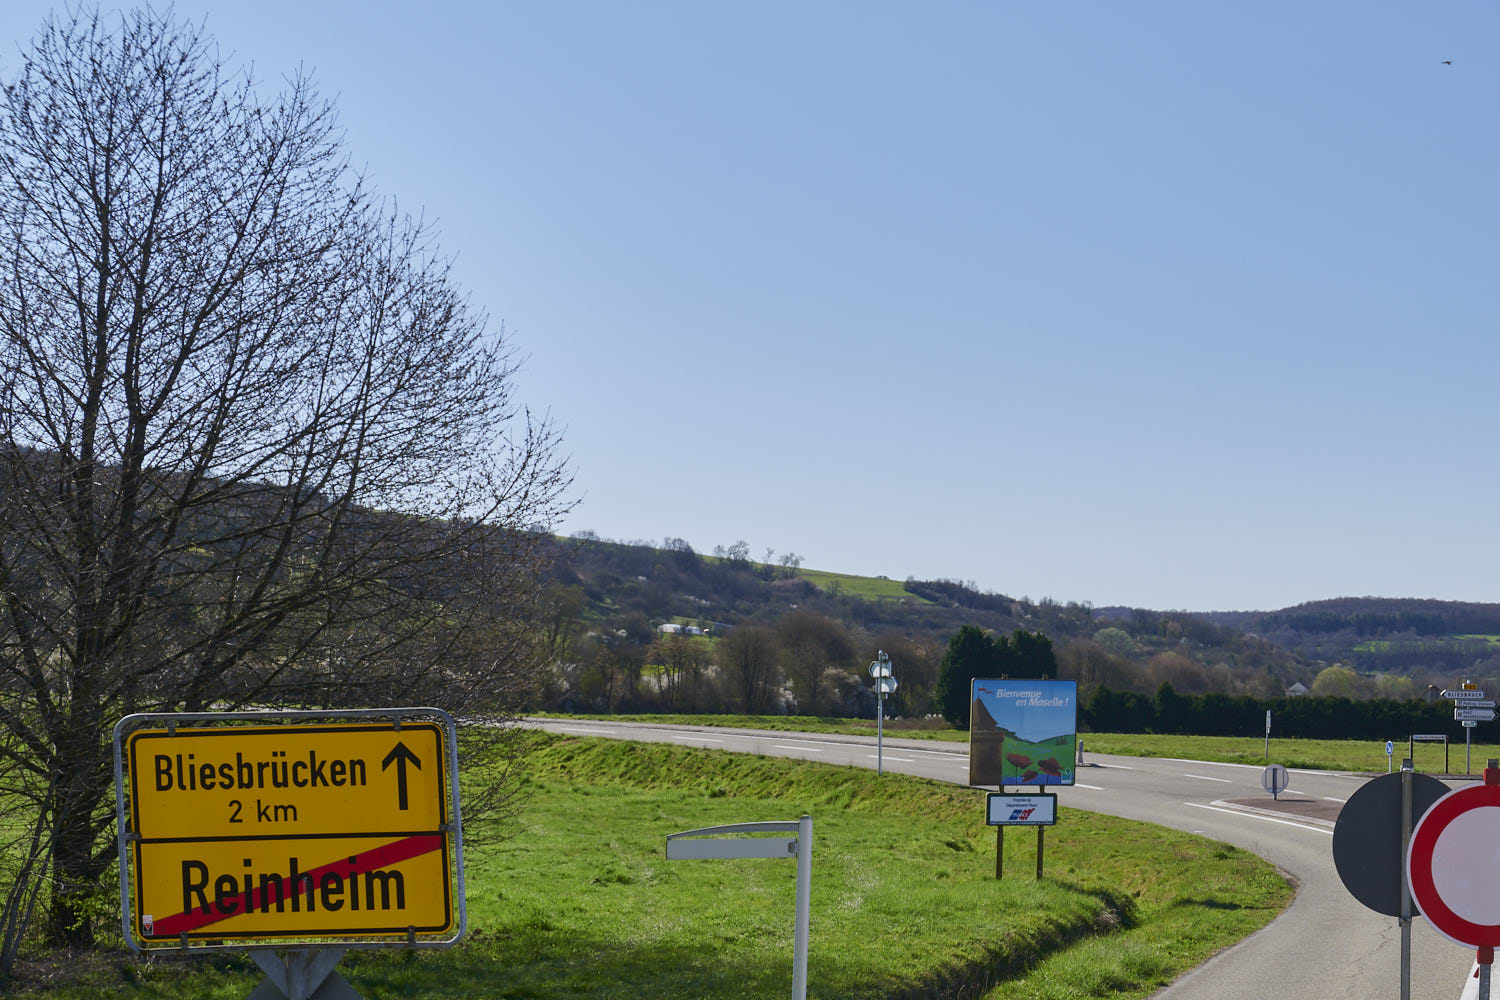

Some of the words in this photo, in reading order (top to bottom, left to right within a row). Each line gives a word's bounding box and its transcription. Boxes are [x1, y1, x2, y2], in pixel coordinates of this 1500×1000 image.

[996, 688, 1042, 698] Bienvenue
[1028, 697, 1063, 707] Moselle
[154, 750, 367, 792] Bliesbrücken
[228, 800, 243, 824] 2
[256, 799, 298, 823] km
[181, 856, 406, 916] Reinheim
